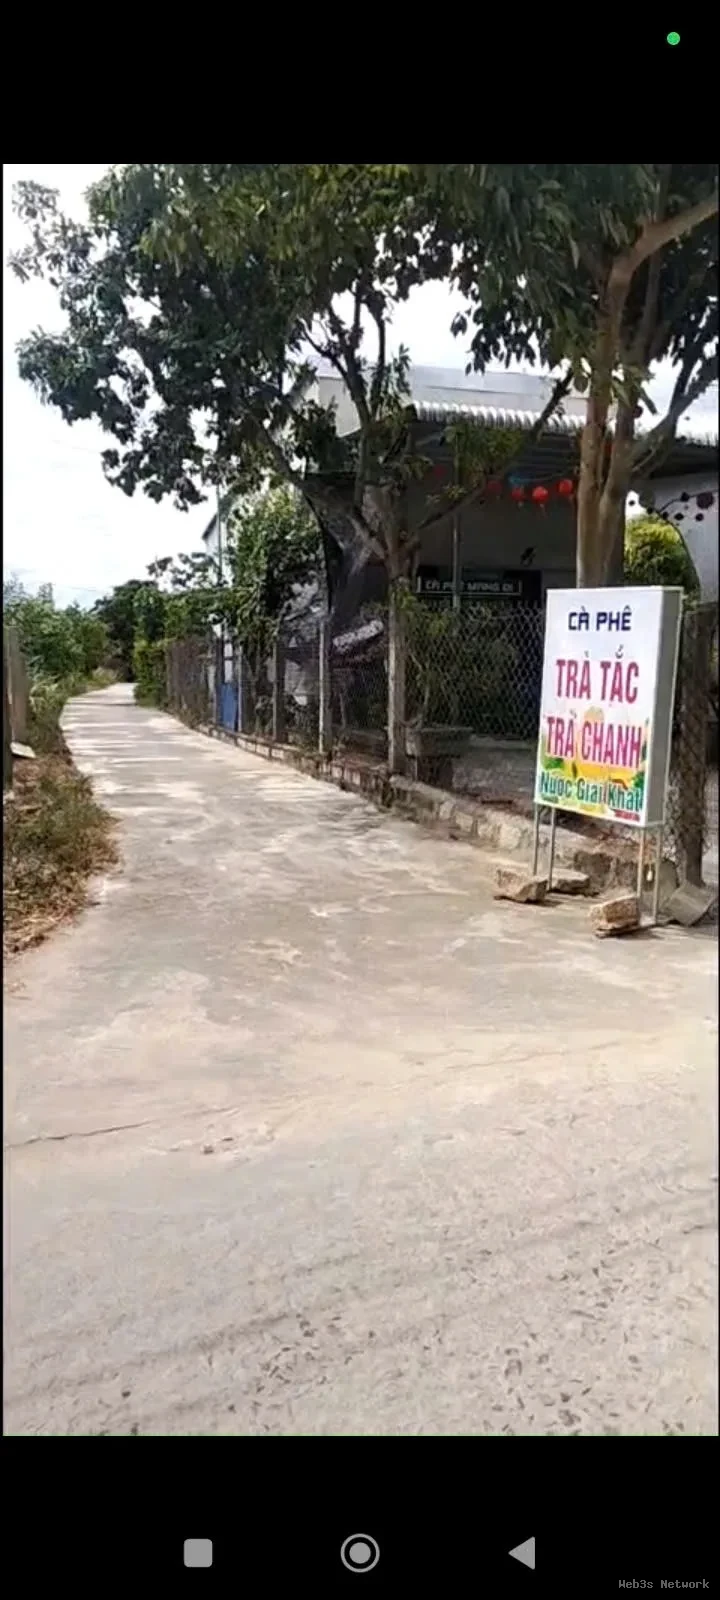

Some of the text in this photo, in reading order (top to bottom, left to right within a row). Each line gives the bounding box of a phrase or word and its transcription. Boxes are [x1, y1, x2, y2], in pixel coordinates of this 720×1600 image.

[568, 605, 632, 631] CÀ PHÊ
[556, 644, 639, 704] TRÀ TẮC
[547, 710, 642, 768] TRÀ CHANH
